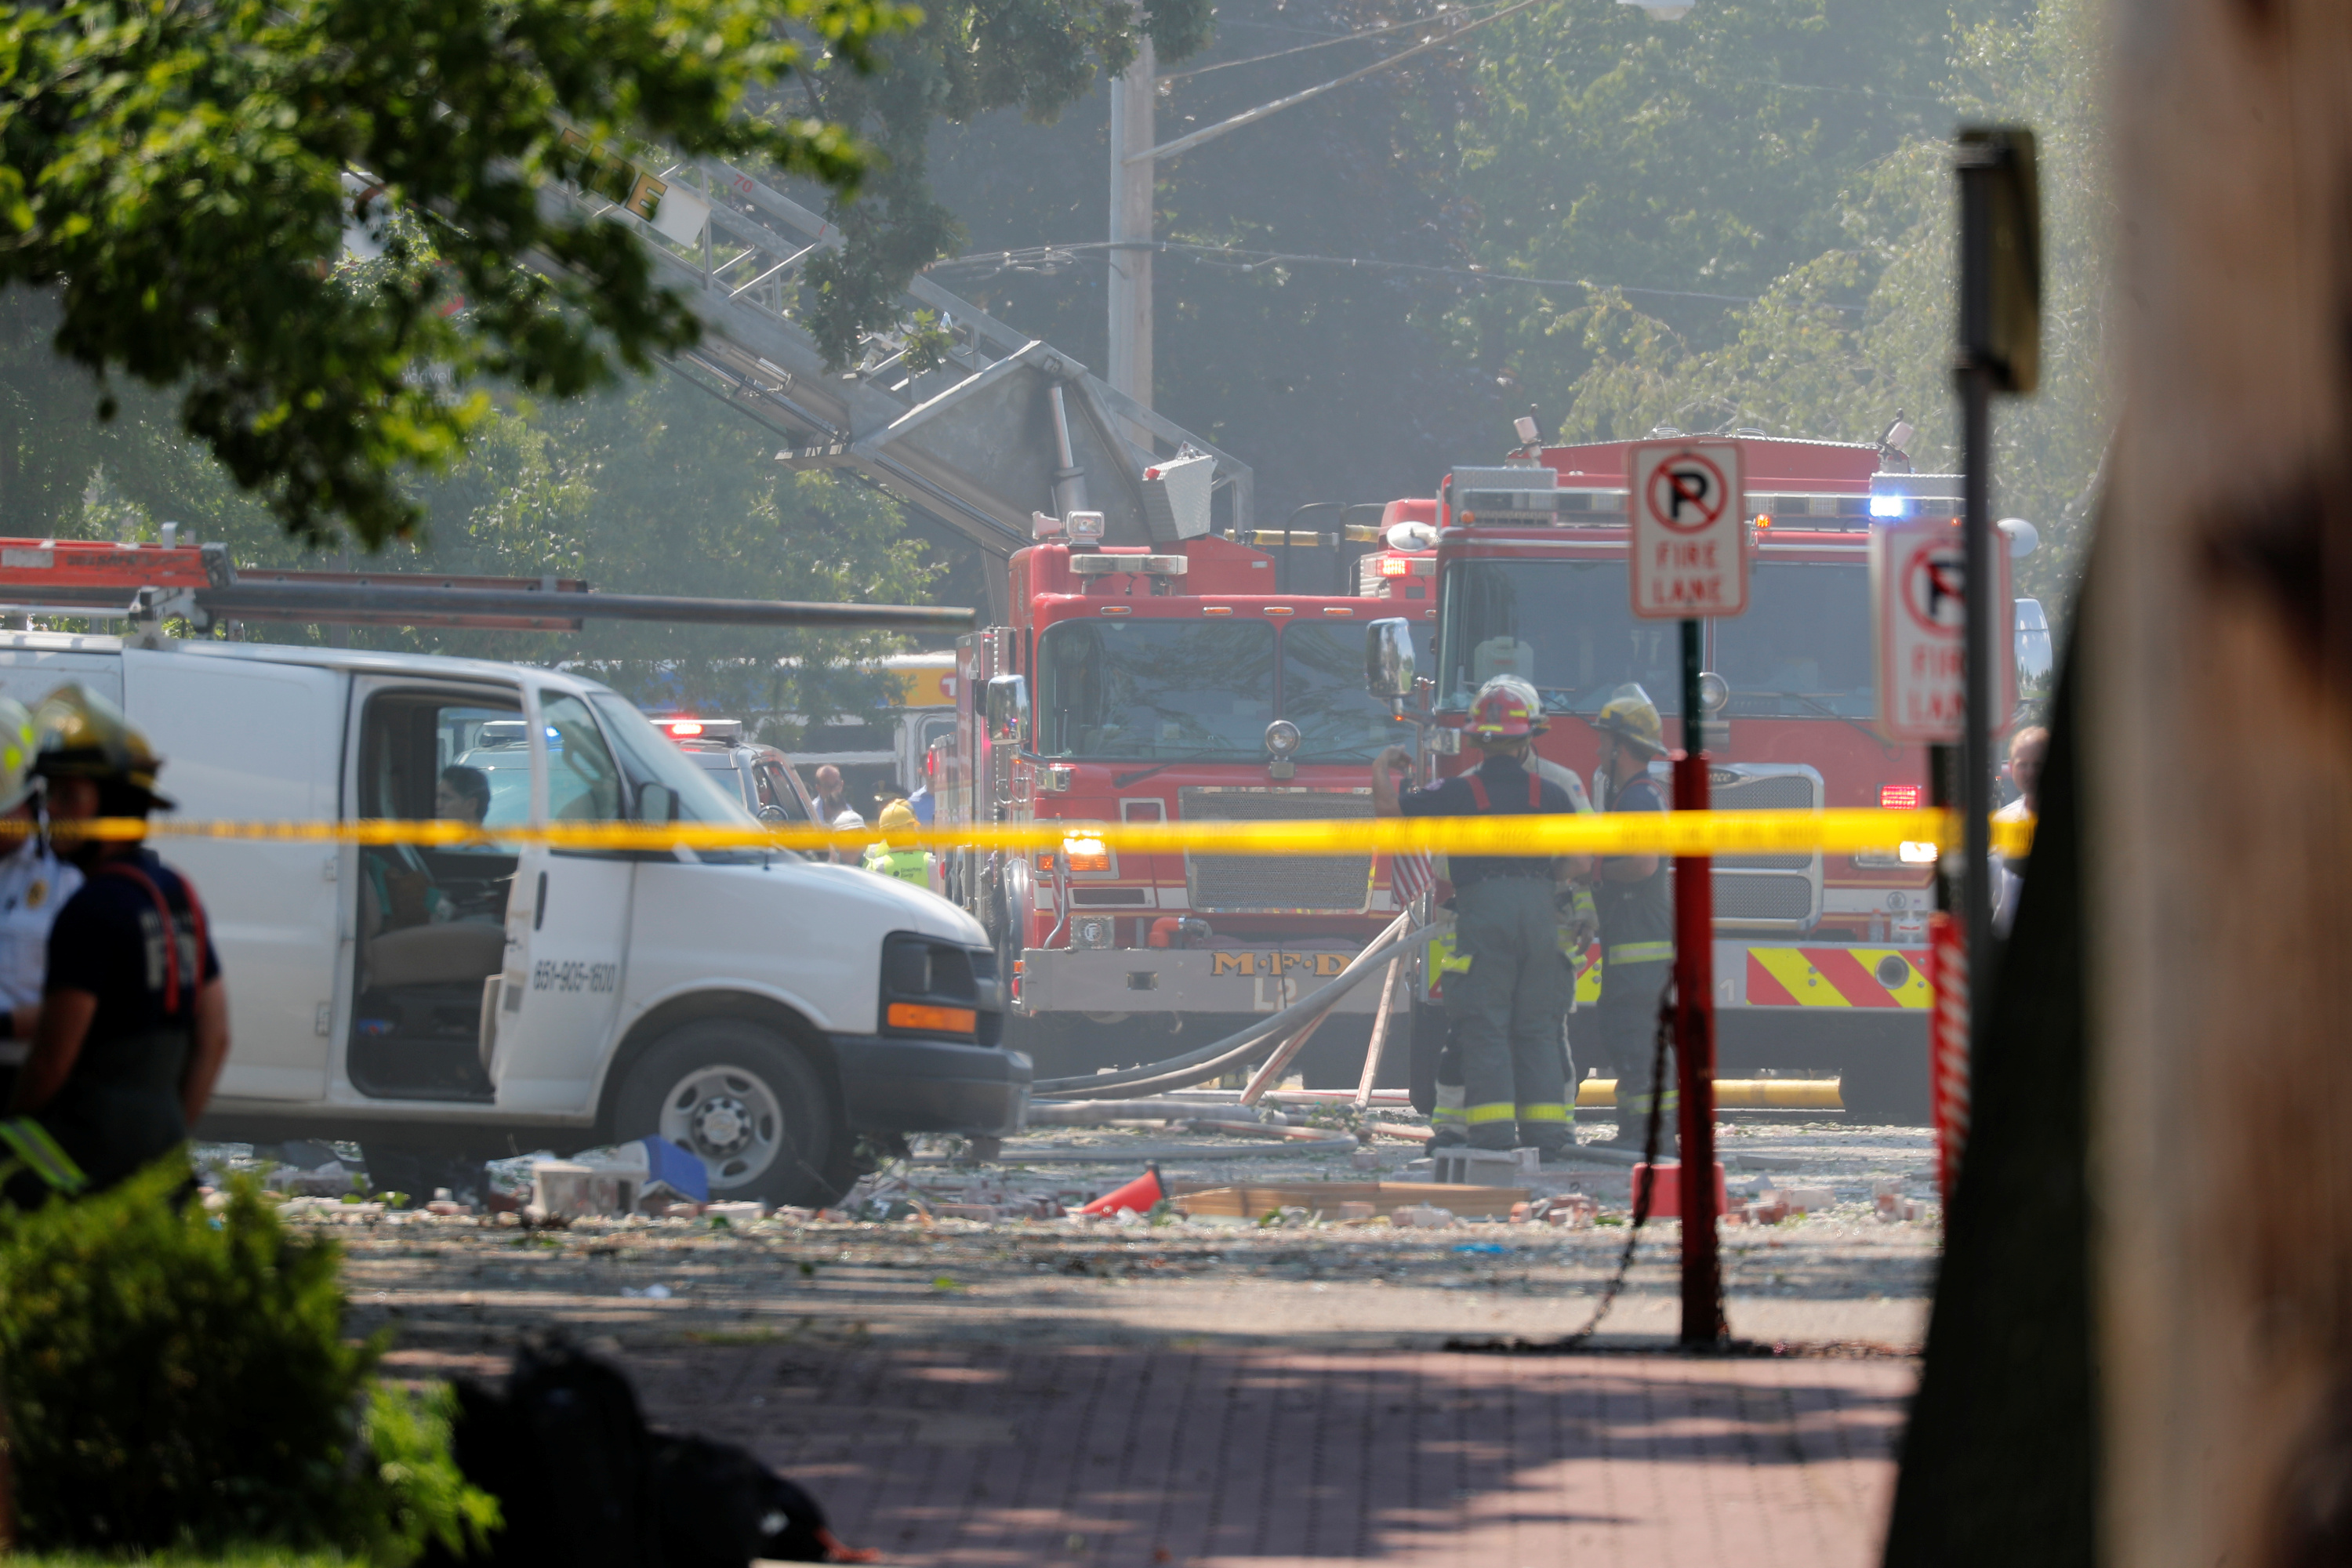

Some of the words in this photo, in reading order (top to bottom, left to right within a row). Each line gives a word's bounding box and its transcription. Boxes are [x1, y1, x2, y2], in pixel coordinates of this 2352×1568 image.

[733, 173, 753, 193] 70
[1656, 539, 1718, 569] FIRE
[1653, 577, 1722, 604] LANE
